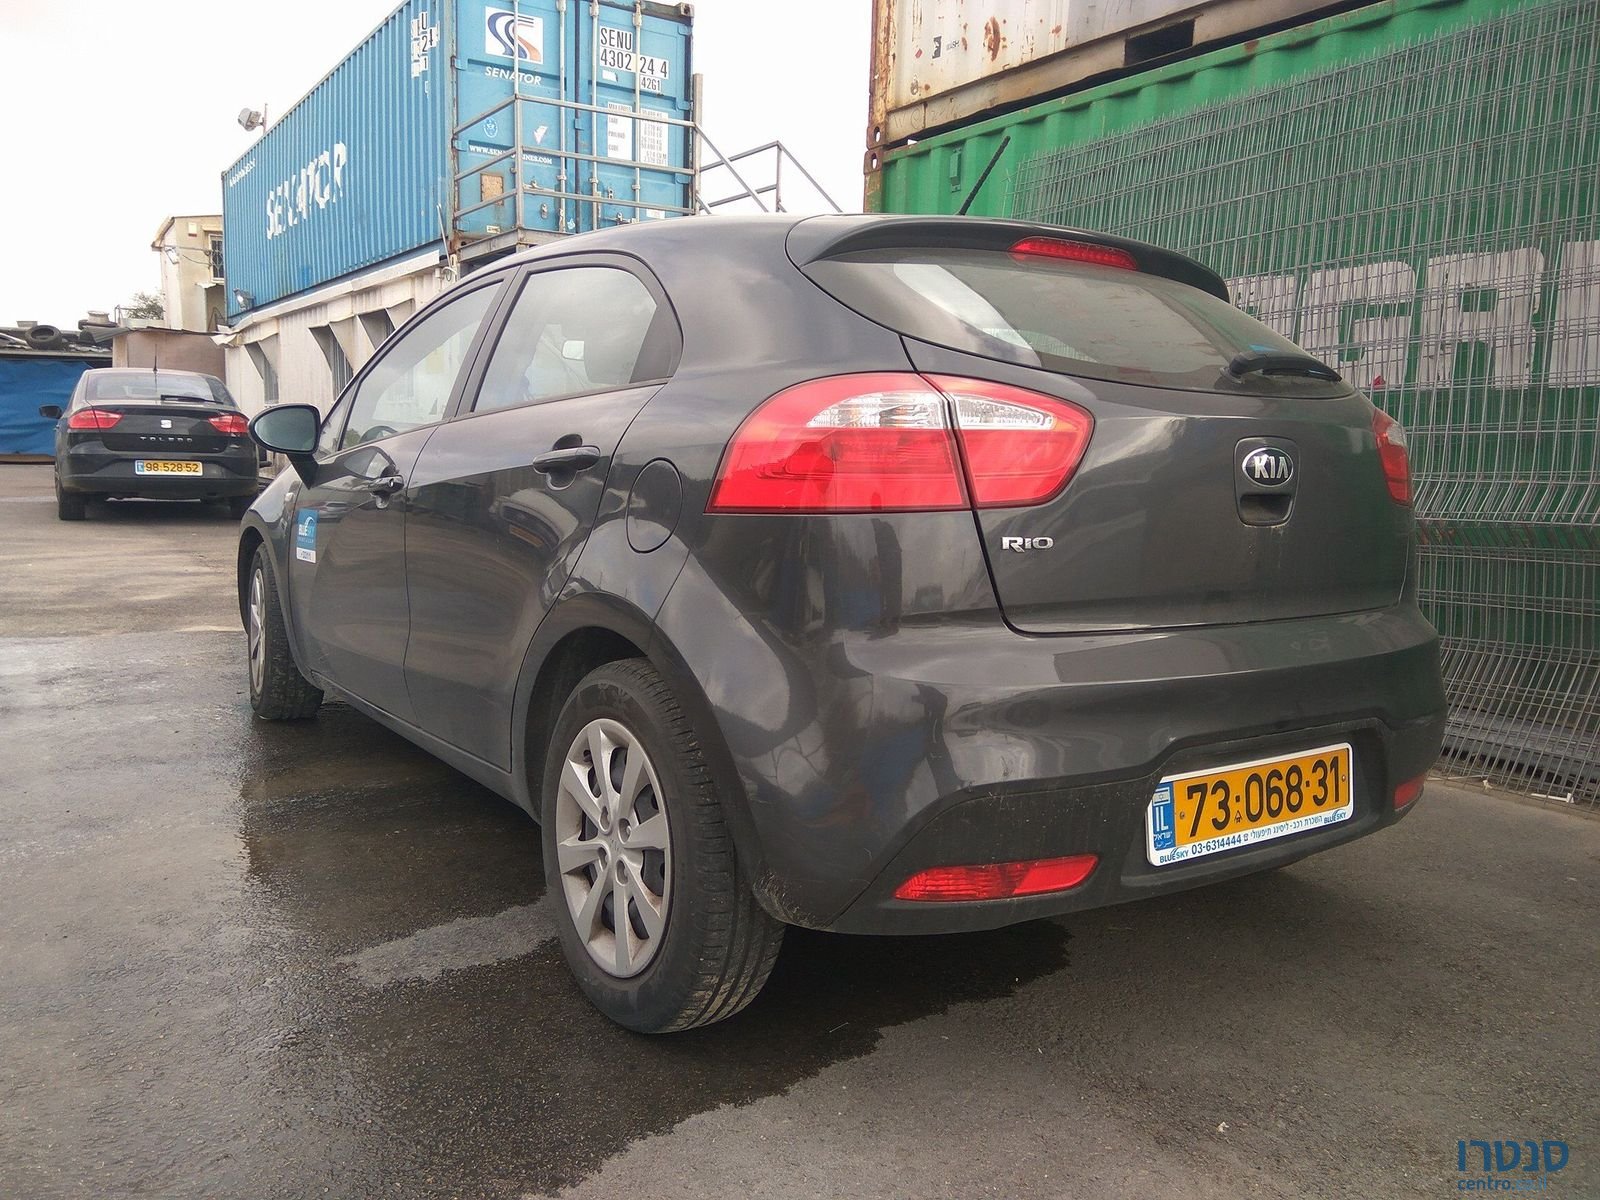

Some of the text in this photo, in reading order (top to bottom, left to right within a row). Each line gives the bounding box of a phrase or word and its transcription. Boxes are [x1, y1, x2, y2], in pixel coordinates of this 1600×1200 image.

[600, 27, 632, 51] SENU
[600, 48, 632, 71] 4302
[660, 61, 668, 78] 4
[484, 66, 542, 85] SENATOR
[641, 77, 661, 91] 42G1
[1254, 455, 1290, 479] KIA
[1155, 806, 1169, 832] IL
[1191, 834, 1242, 855] 03-6314444
